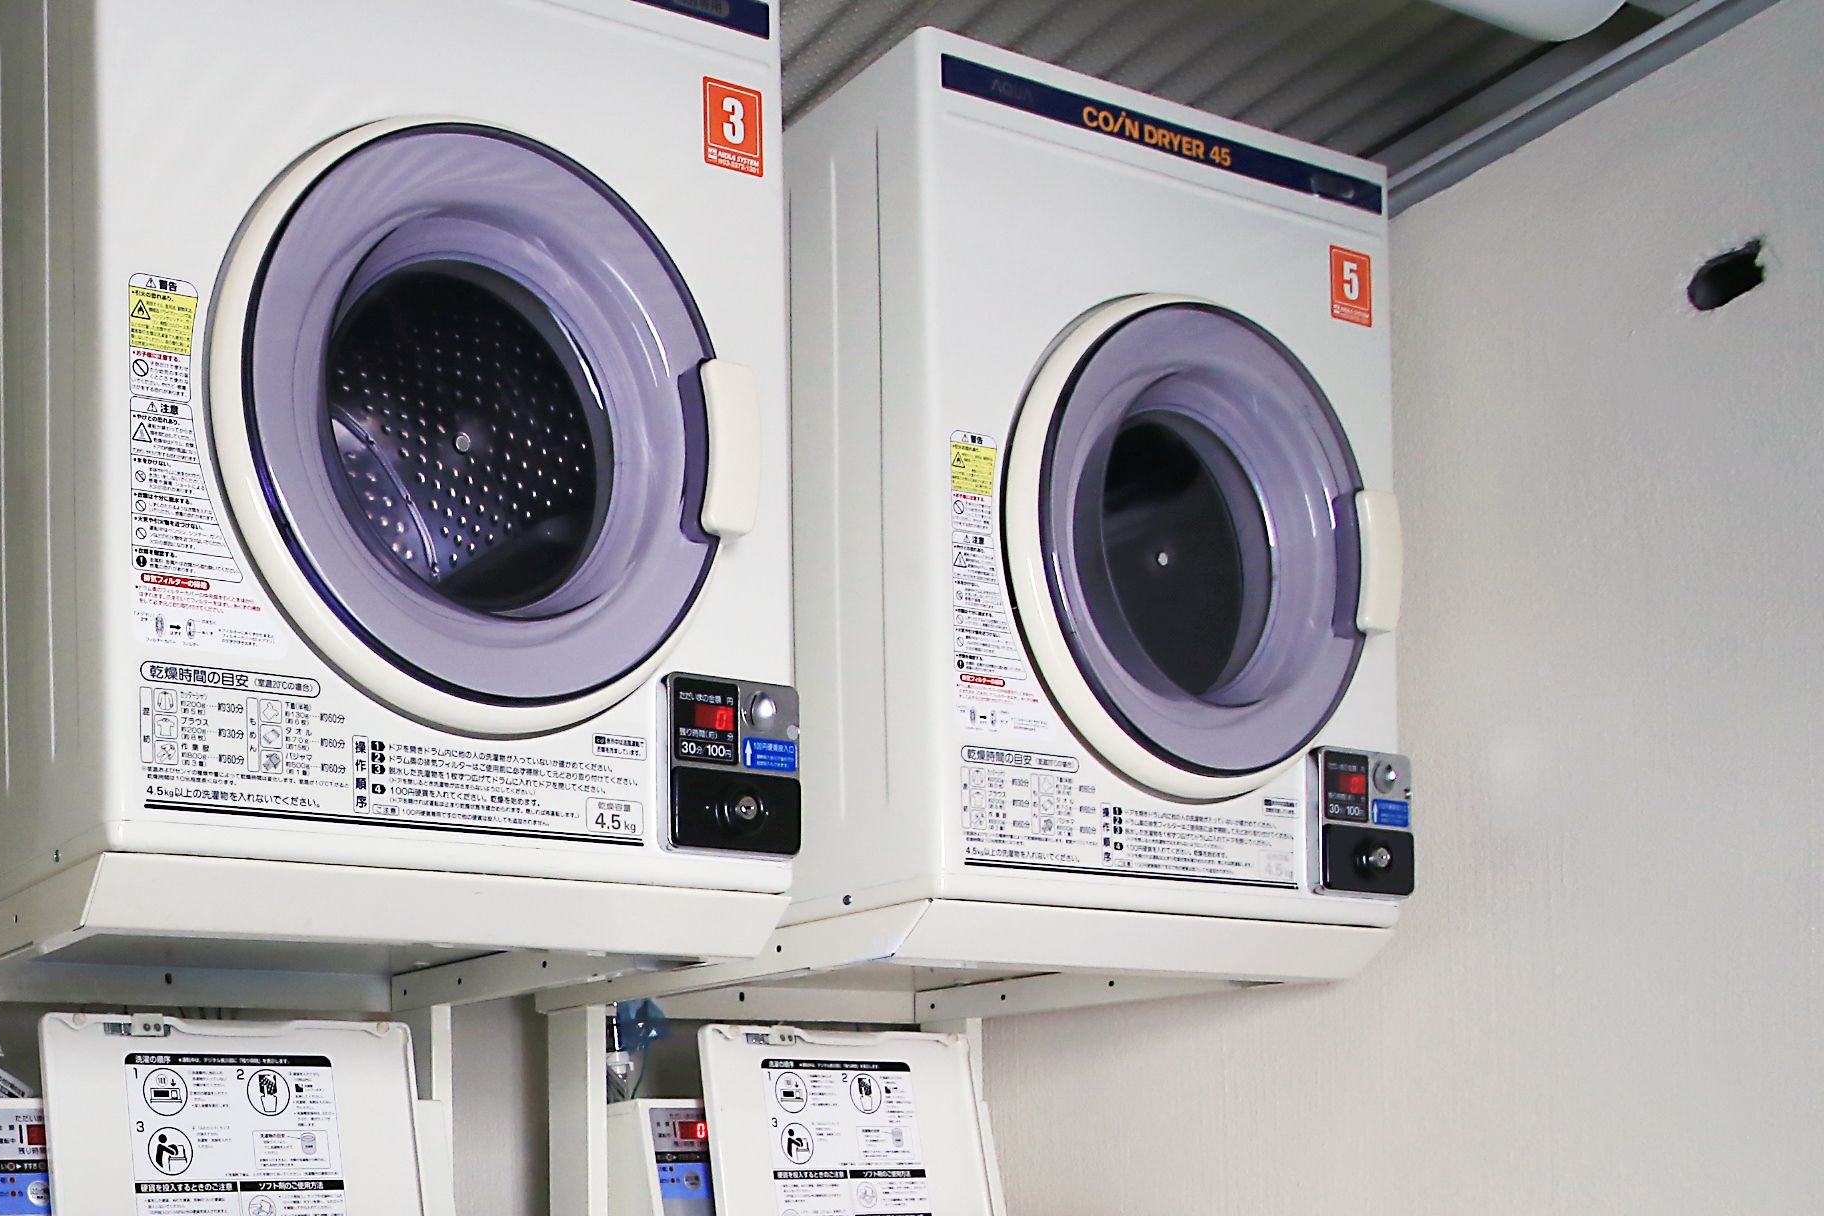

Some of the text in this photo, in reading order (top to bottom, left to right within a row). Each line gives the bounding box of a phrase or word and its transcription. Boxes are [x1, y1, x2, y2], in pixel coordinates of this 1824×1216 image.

[723, 97, 744, 144] 3
[1144, 124, 1204, 159] DRYER
[1210, 146, 1231, 166] 45
[159, 280, 177, 292] 警告
[1344, 261, 1359, 300] 5
[161, 403, 178, 415] 注意
[149, 665, 248, 688] 乾燥時間の目安
[716, 706, 726, 729] 0
[374, 742, 380, 750] 1
[967, 749, 1032, 765] 乾燥時間の目安
[374, 765, 381, 773] 3
[374, 785, 382, 793] 4
[595, 812, 636, 833] 4.5 kg
[133, 1068, 138, 1079] 1
[237, 1069, 244, 1080] 2
[768, 1072, 771, 1080] 1
[842, 1073, 848, 1082] 2
[136, 1121, 145, 1132] 3
[772, 1117, 777, 1127] 3
[697, 1123, 705, 1138] 0
[141, 1183, 233, 1192] 硬貨を投入するときのご注意
[259, 1182, 324, 1190] ソフト剤のご使用方法
